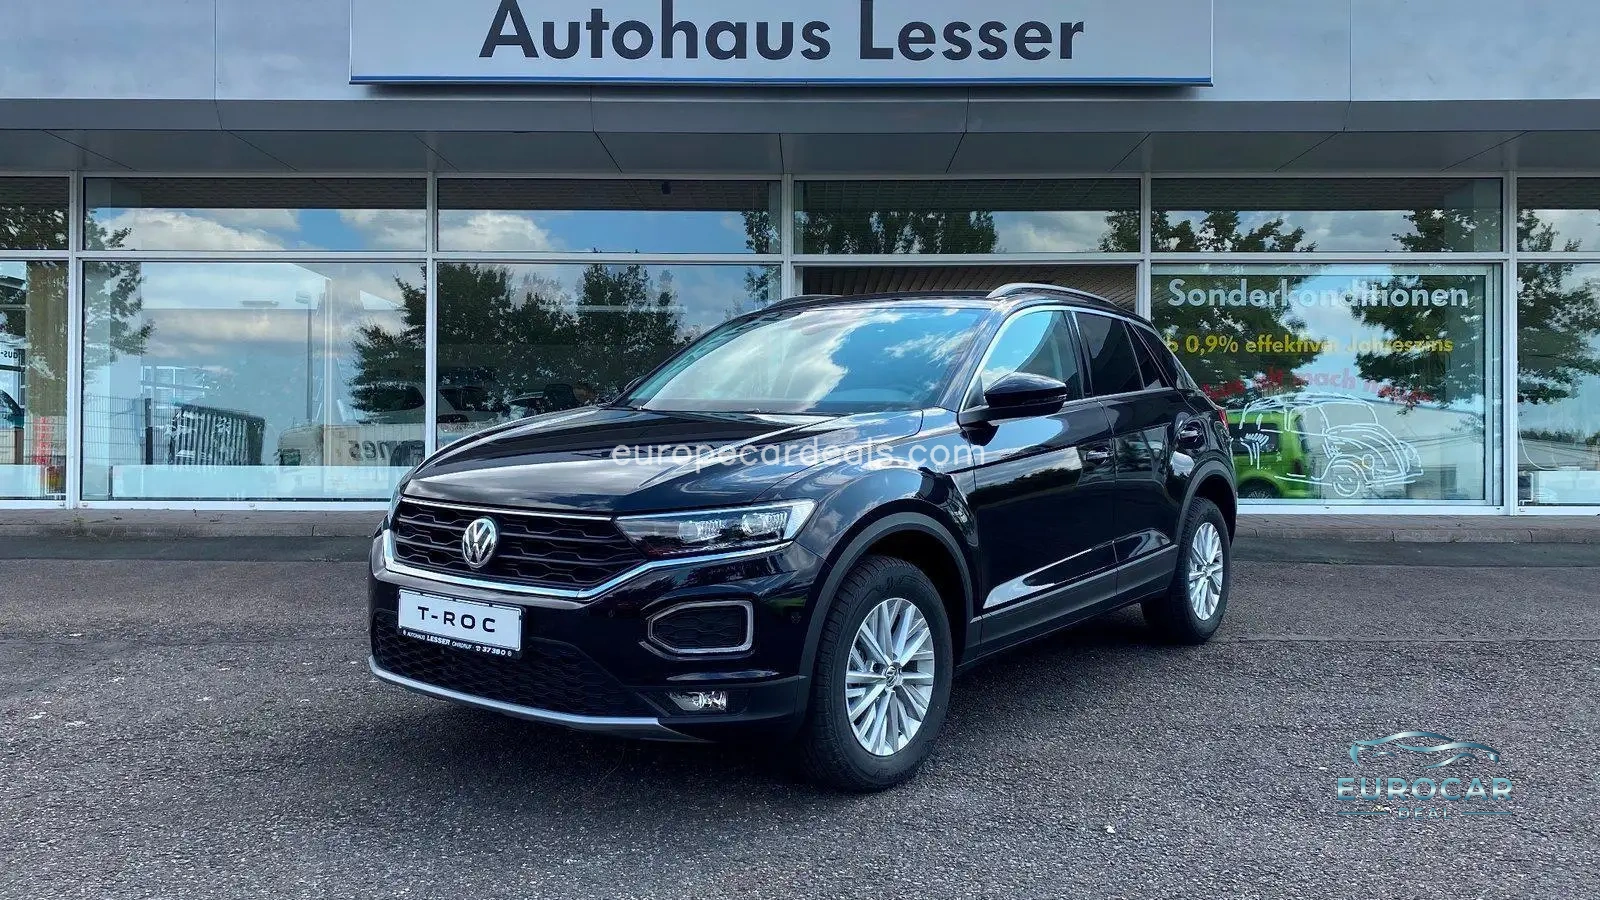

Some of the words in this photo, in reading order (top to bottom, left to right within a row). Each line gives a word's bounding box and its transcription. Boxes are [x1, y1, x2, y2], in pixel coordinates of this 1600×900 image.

[479, 0, 831, 60] Autohaus
[859, 0, 1084, 61] Lesser
[1168, 279, 1469, 308] Sonderkonditionen
[1186, 334, 1239, 356] 0,9%
[417, 605, 496, 633] T-ROC
[426, 635, 451, 646] LESSER
